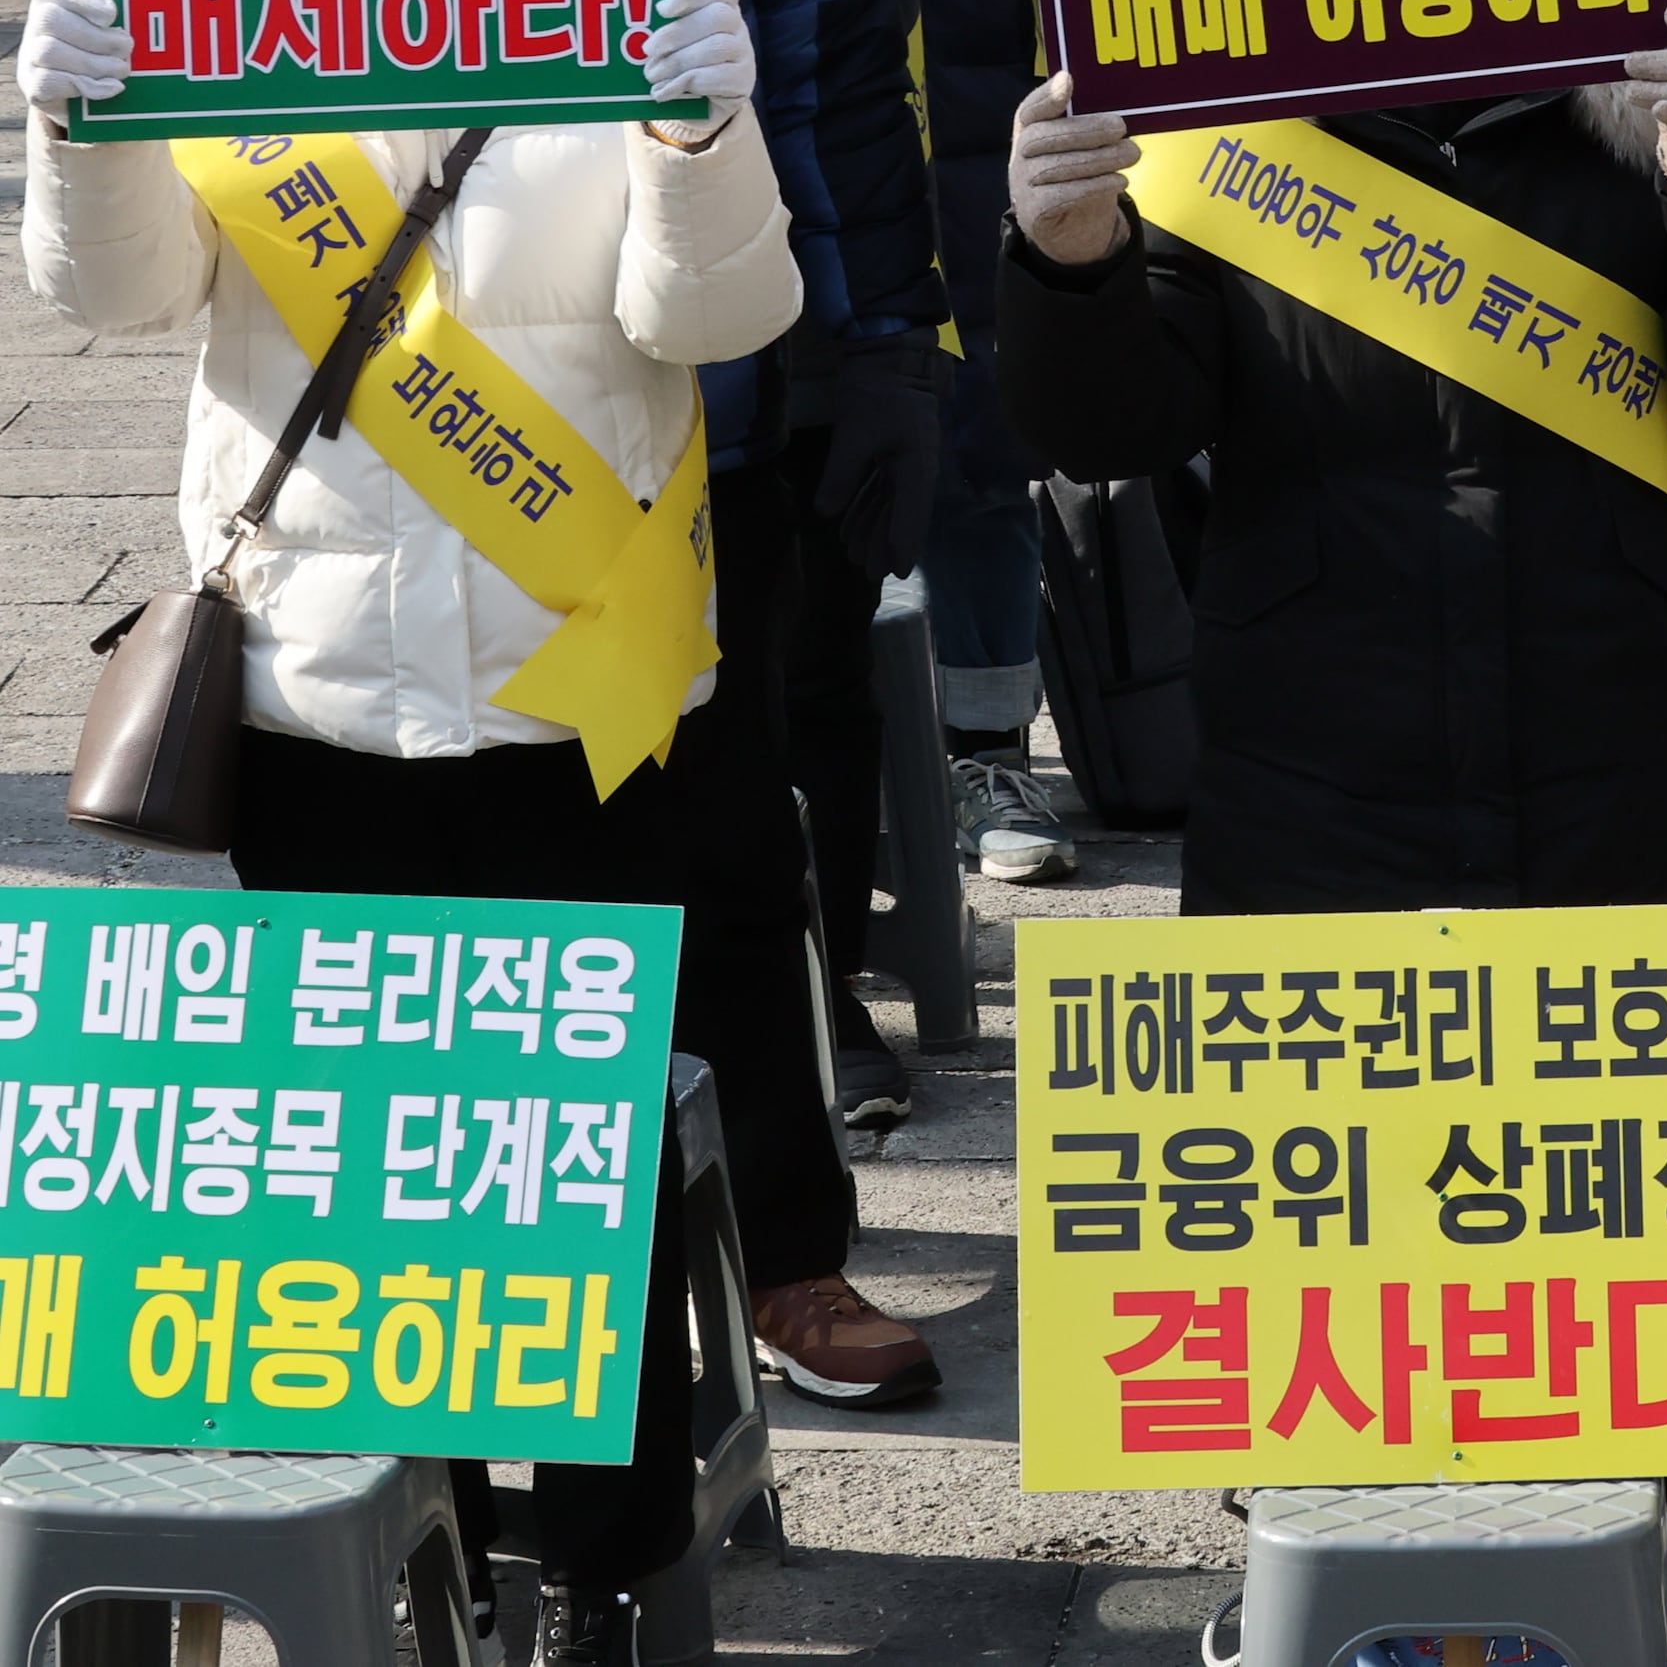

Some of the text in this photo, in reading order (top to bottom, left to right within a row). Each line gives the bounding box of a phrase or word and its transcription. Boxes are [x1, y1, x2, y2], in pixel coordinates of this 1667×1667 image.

[1199, 136, 1357, 250] 금융위
[81, 923, 636, 1060] 배임 분리적용
[1048, 964, 1494, 1095] 피해주주권리
[382, 1092, 633, 1230] 단계적
[1046, 1124, 1371, 1253] 금융위
[128, 1255, 618, 1419] 허용하라
